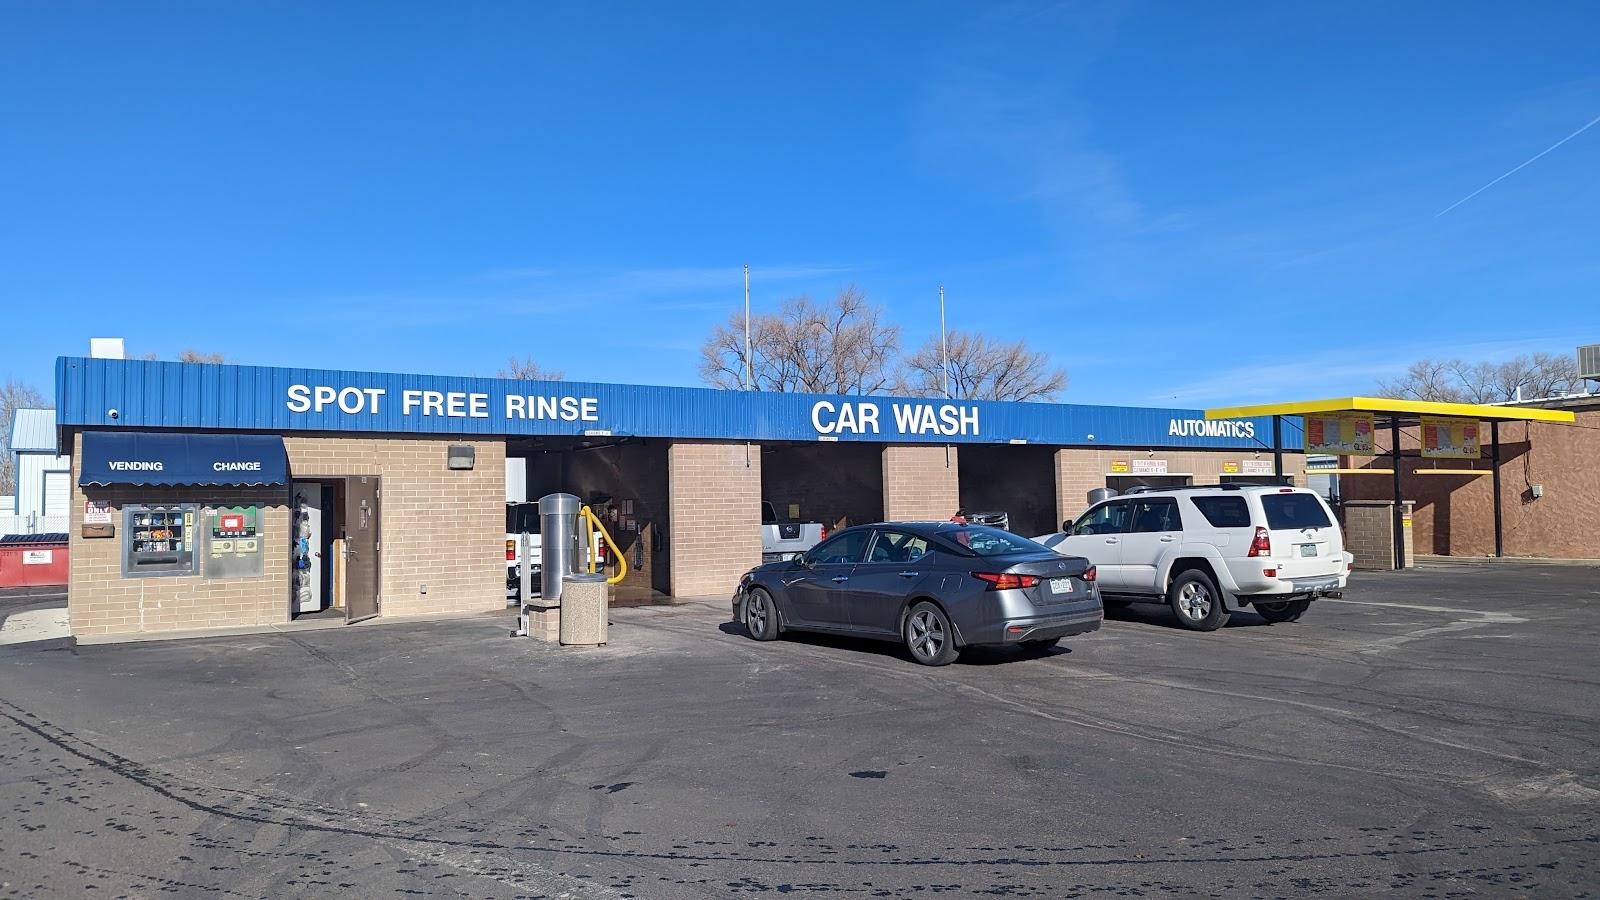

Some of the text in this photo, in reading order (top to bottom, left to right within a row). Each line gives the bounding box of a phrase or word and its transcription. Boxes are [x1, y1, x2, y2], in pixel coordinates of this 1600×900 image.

[286, 384, 599, 422] SPOT FREE RINSE
[811, 401, 980, 436] CAR WASH
[1168, 418, 1255, 439] AUTOMATICS
[108, 461, 163, 471] VENDING
[213, 461, 261, 471] CHANGE
